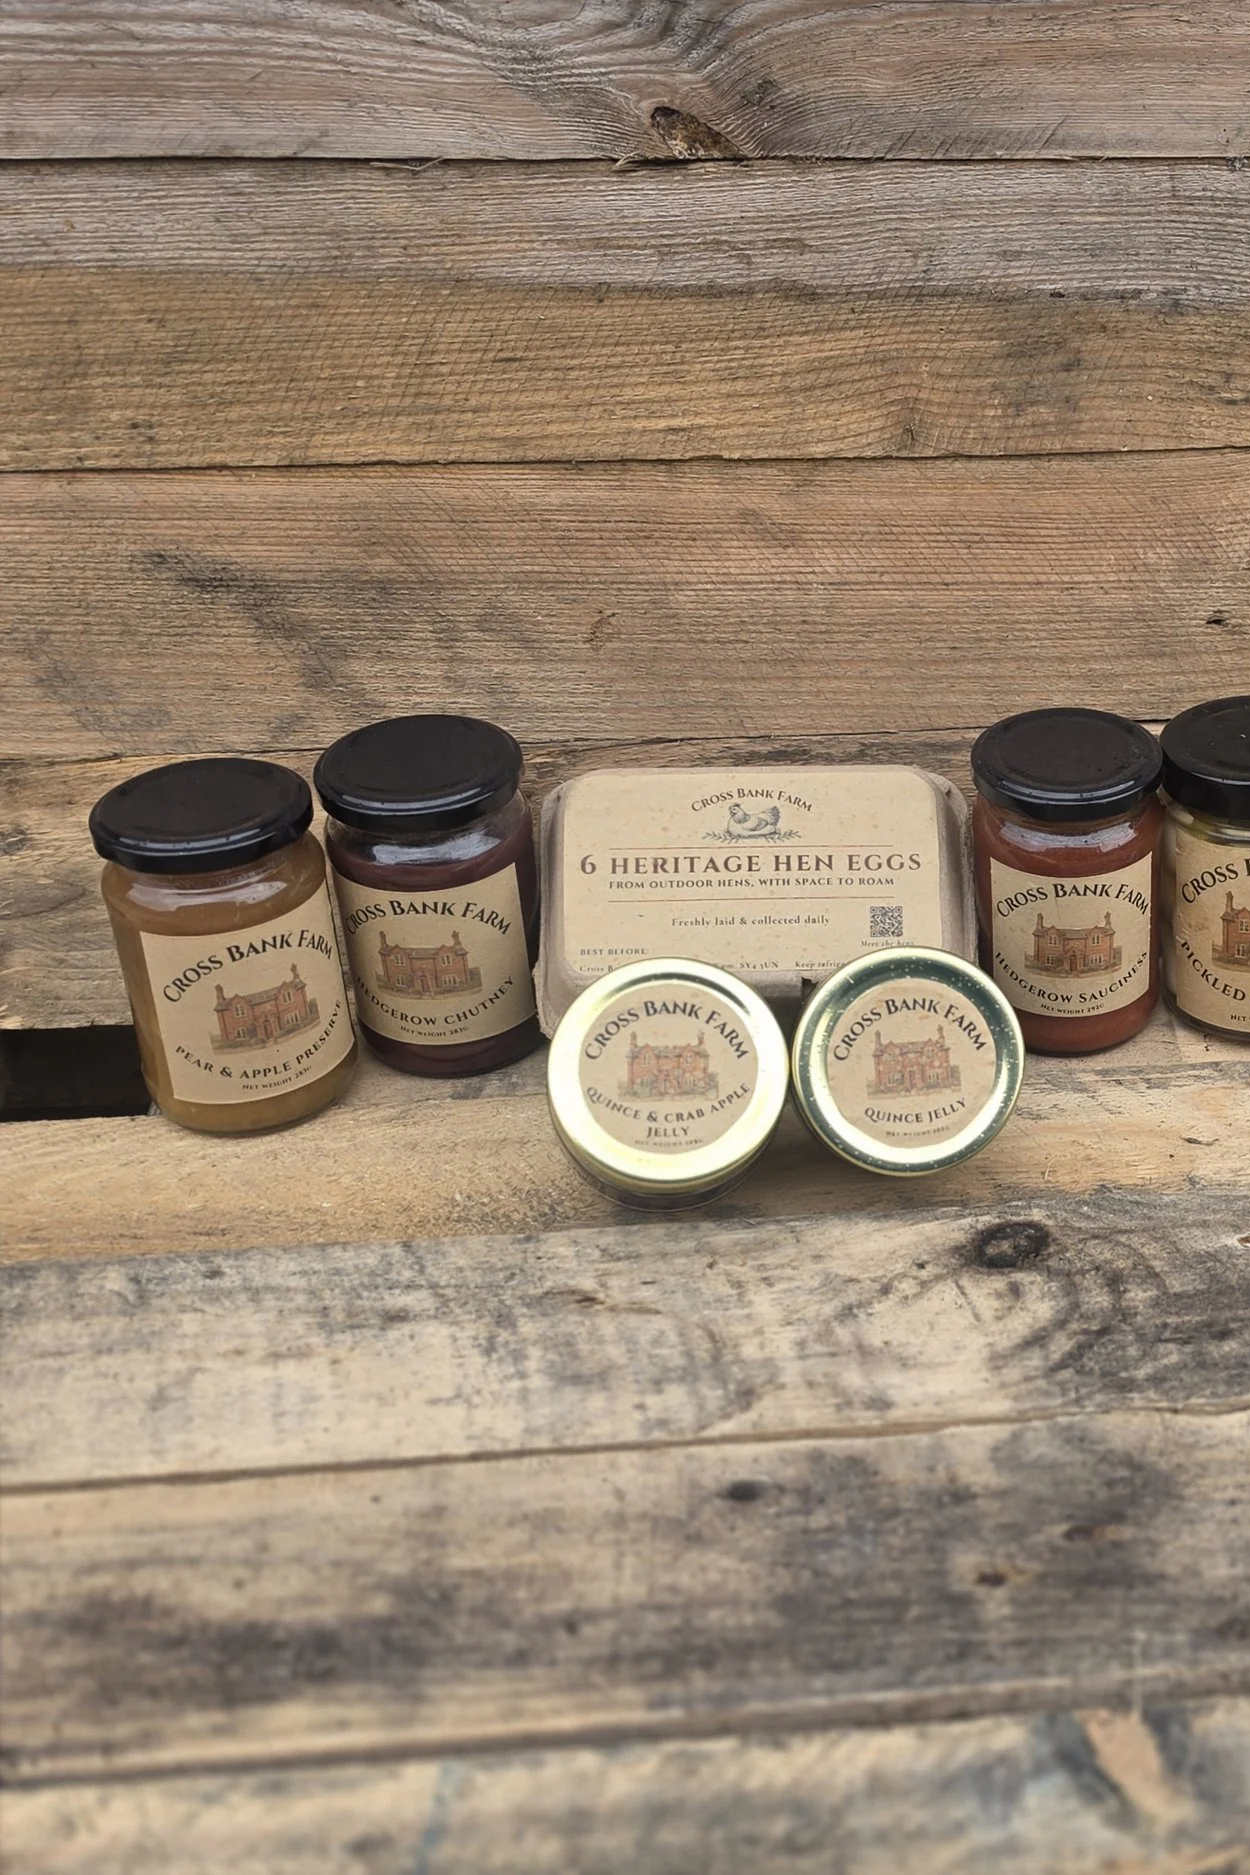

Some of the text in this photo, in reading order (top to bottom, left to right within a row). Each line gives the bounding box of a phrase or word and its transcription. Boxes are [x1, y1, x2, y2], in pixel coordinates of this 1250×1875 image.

[691, 788, 813, 812] CROSS BANK FARM
[580, 853, 921, 875] 6 HERITAGE HEN EGGS
[609, 877, 894, 889] FROM OUTDOOR HENS, WITH SPACE TO ROAM
[996, 883, 1149, 918] CROSS BANK FARM
[1181, 862, 1239, 904] CROSS
[346, 900, 512, 935] CROSS BANK FARM
[672, 914, 830, 929] Freshly laid & collected daily
[162, 929, 332, 1003] CROSS BANK FARM
[995, 951, 1148, 1004] HEDGEROW SAUCINESS
[1181, 941, 1246, 1002] PICKLED
[356, 975, 514, 1026] HEDGEROW CHUTNEY
[1230, 1014, 1246, 1022] NET
[584, 1000, 749, 1060] CROSS BANK FARM
[833, 997, 988, 1062] CROSS BANK FARM
[175, 1045, 213, 1073] PEAR
[220, 1066, 233, 1078] &
[239, 1060, 292, 1079] APPLE
[586, 1082, 750, 1124] QUINCE & CRAB APPLE
[864, 1097, 967, 1124] QUINCE JELLY
[646, 1125, 690, 1138] JELLY
